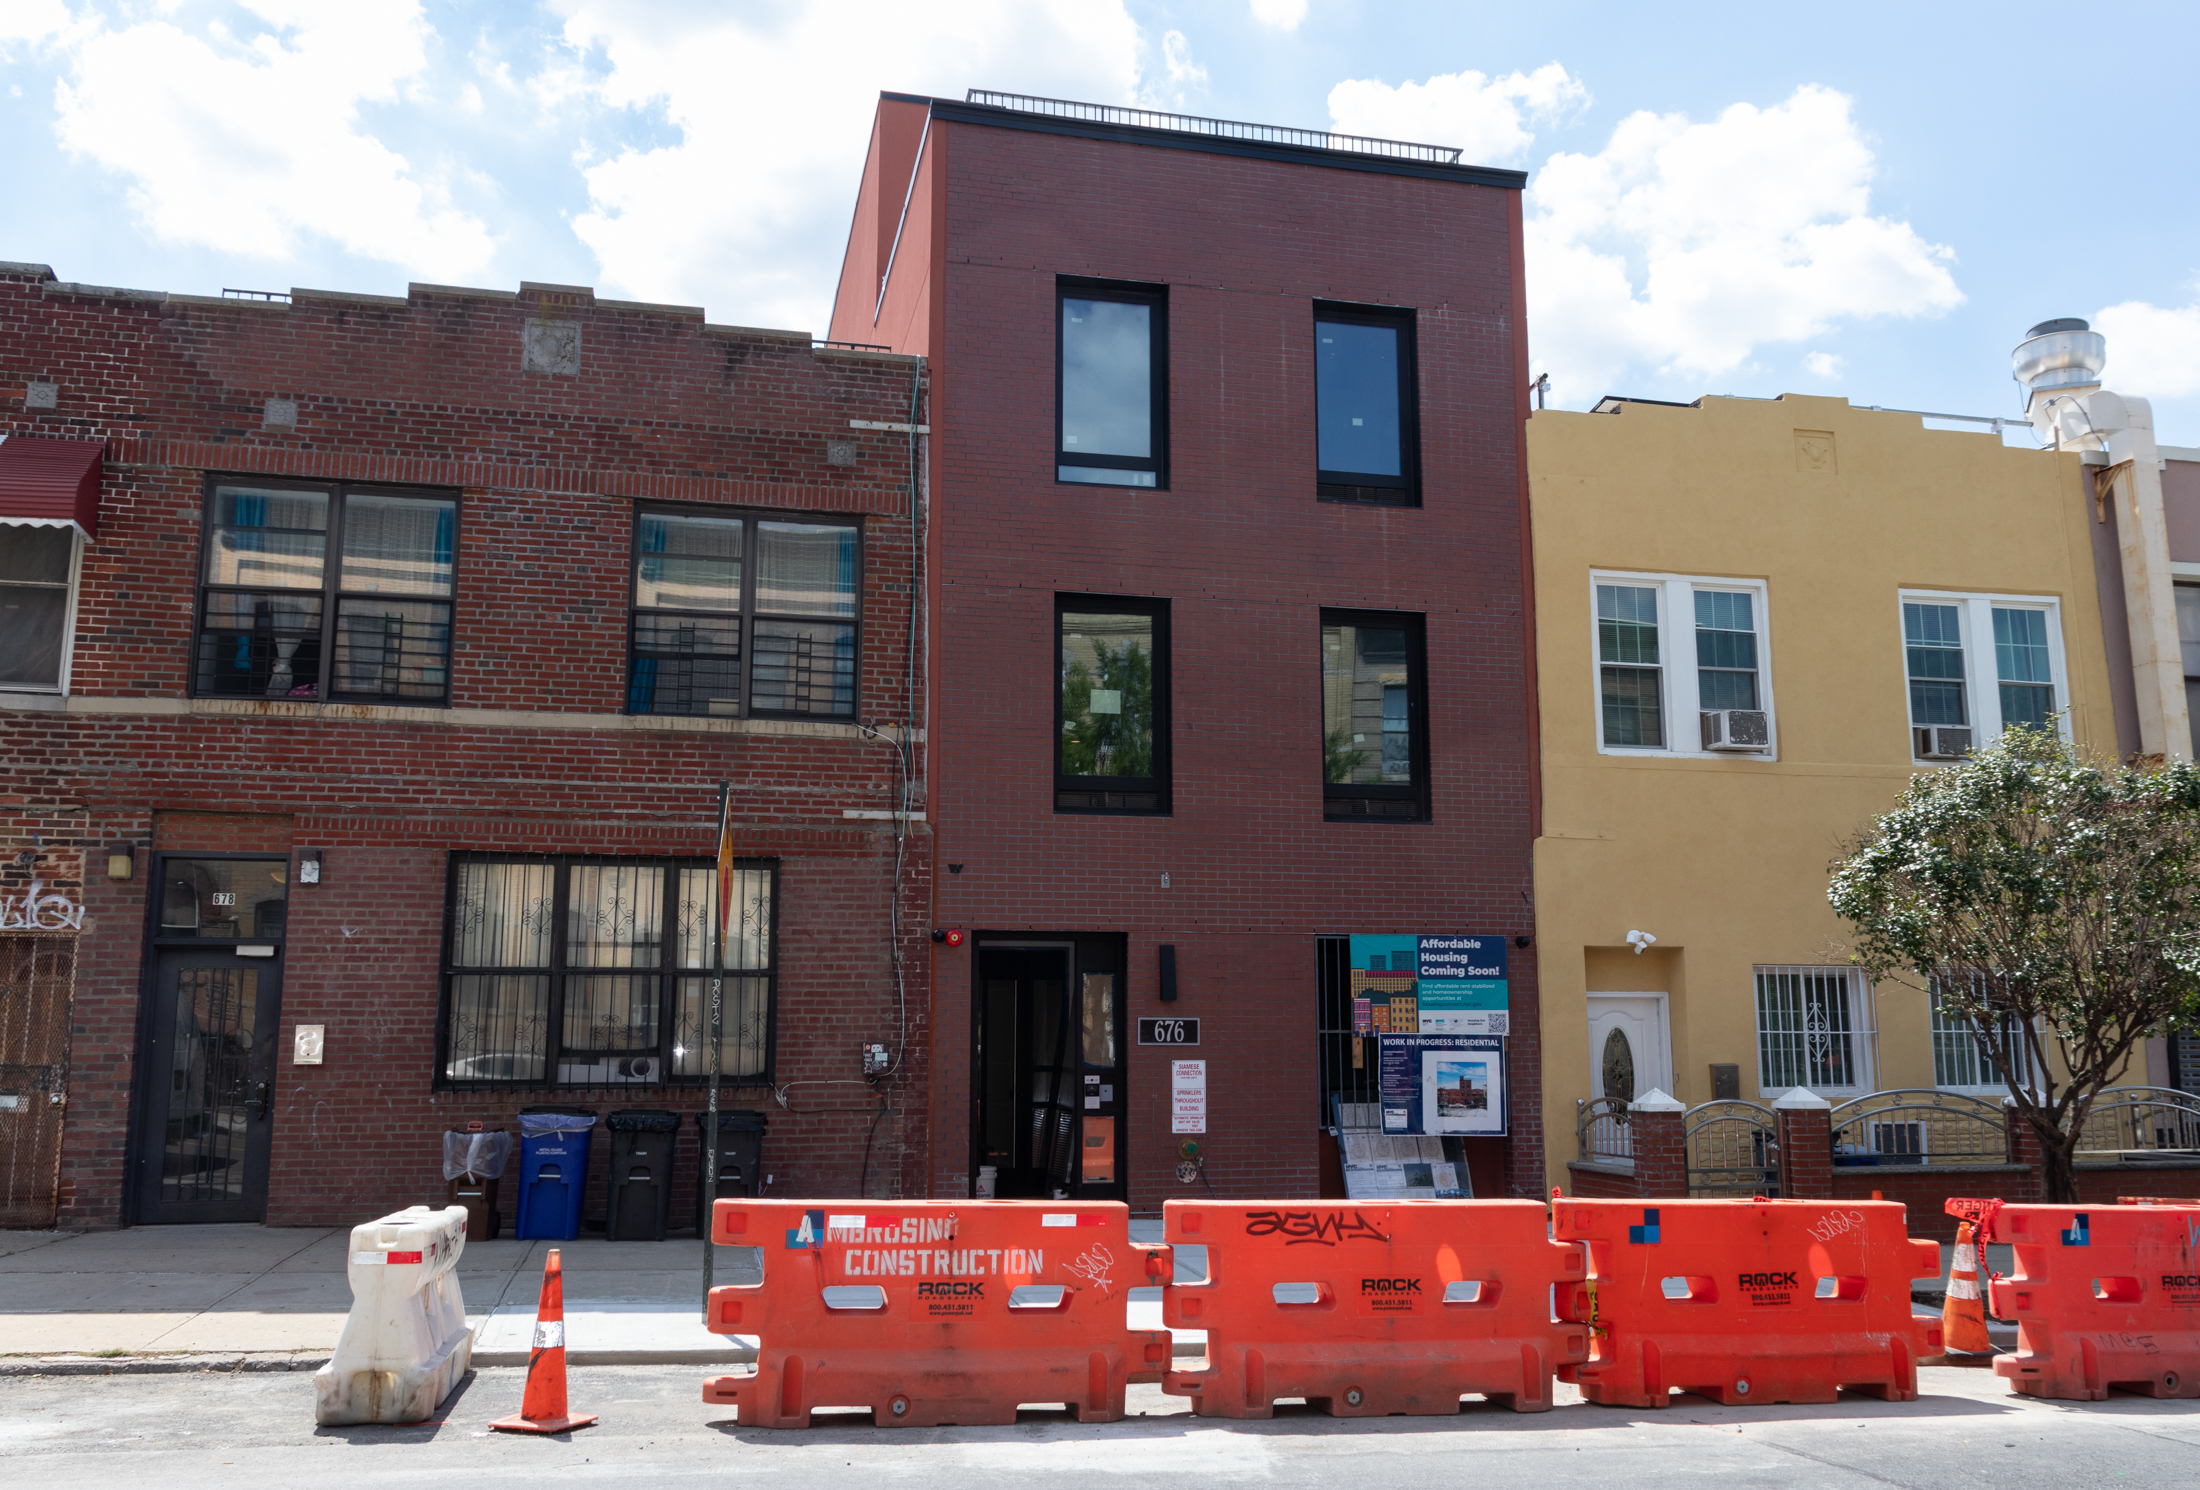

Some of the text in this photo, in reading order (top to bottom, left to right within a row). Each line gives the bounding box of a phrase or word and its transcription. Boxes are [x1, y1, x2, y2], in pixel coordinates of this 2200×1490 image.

[214, 893, 234, 905] 678
[1420, 938, 1481, 949] Affordable
[1420, 951, 1468, 964] Housing
[1421, 965, 1500, 978] Coming Soon!
[1154, 1020, 1185, 1042] 676
[1383, 1038, 1406, 1046] WORK
[1416, 1038, 1454, 1046] PROGRESS:
[1455, 1039, 1500, 1047] RESIDENTIAL
[845, 1249, 1043, 1276] CONSTRUCTION
[1361, 1278, 1422, 1291] ROCK
[1738, 1272, 1798, 1287] ROCK
[2162, 1275, 2200, 1286] ROC
[918, 1282, 985, 1295] ROCK
[1751, 1293, 1791, 1301] 800.451.5811
